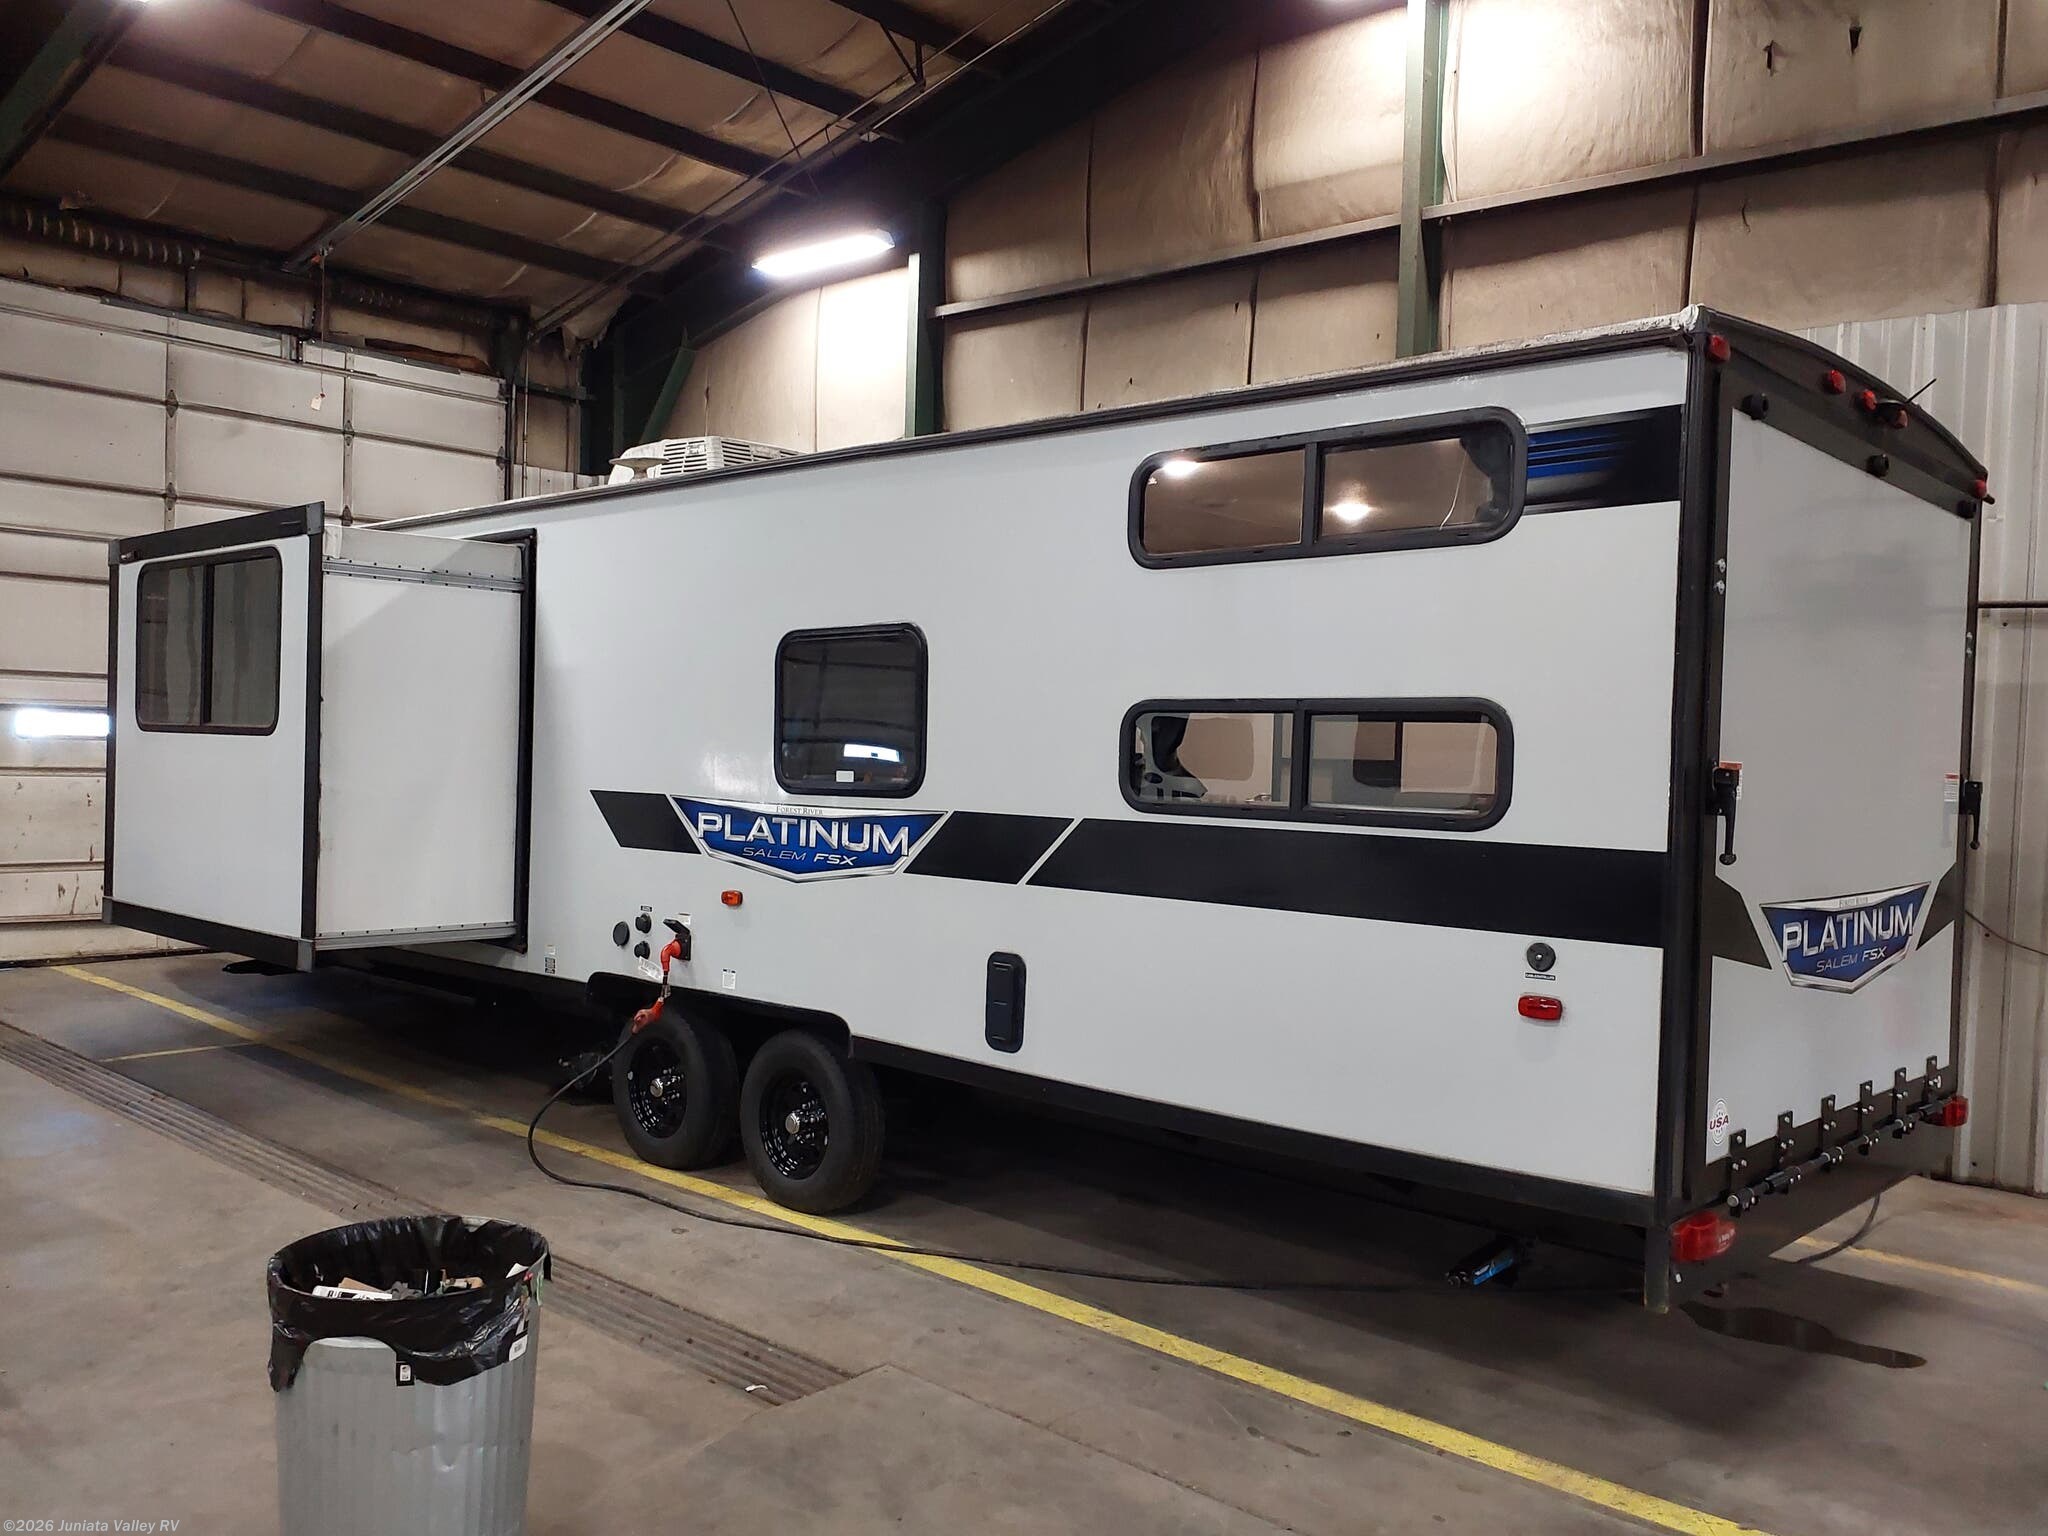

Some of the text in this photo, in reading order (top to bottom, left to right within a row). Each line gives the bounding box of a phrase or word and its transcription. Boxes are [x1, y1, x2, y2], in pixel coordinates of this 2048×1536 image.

[698, 812, 909, 857] PLATINUM
[742, 847, 858, 866] SALEM FSX
[1783, 903, 1914, 961] PLATINUM
[1816, 946, 1888, 973] SALEM FSX
[1709, 1115, 1729, 1130] USA
